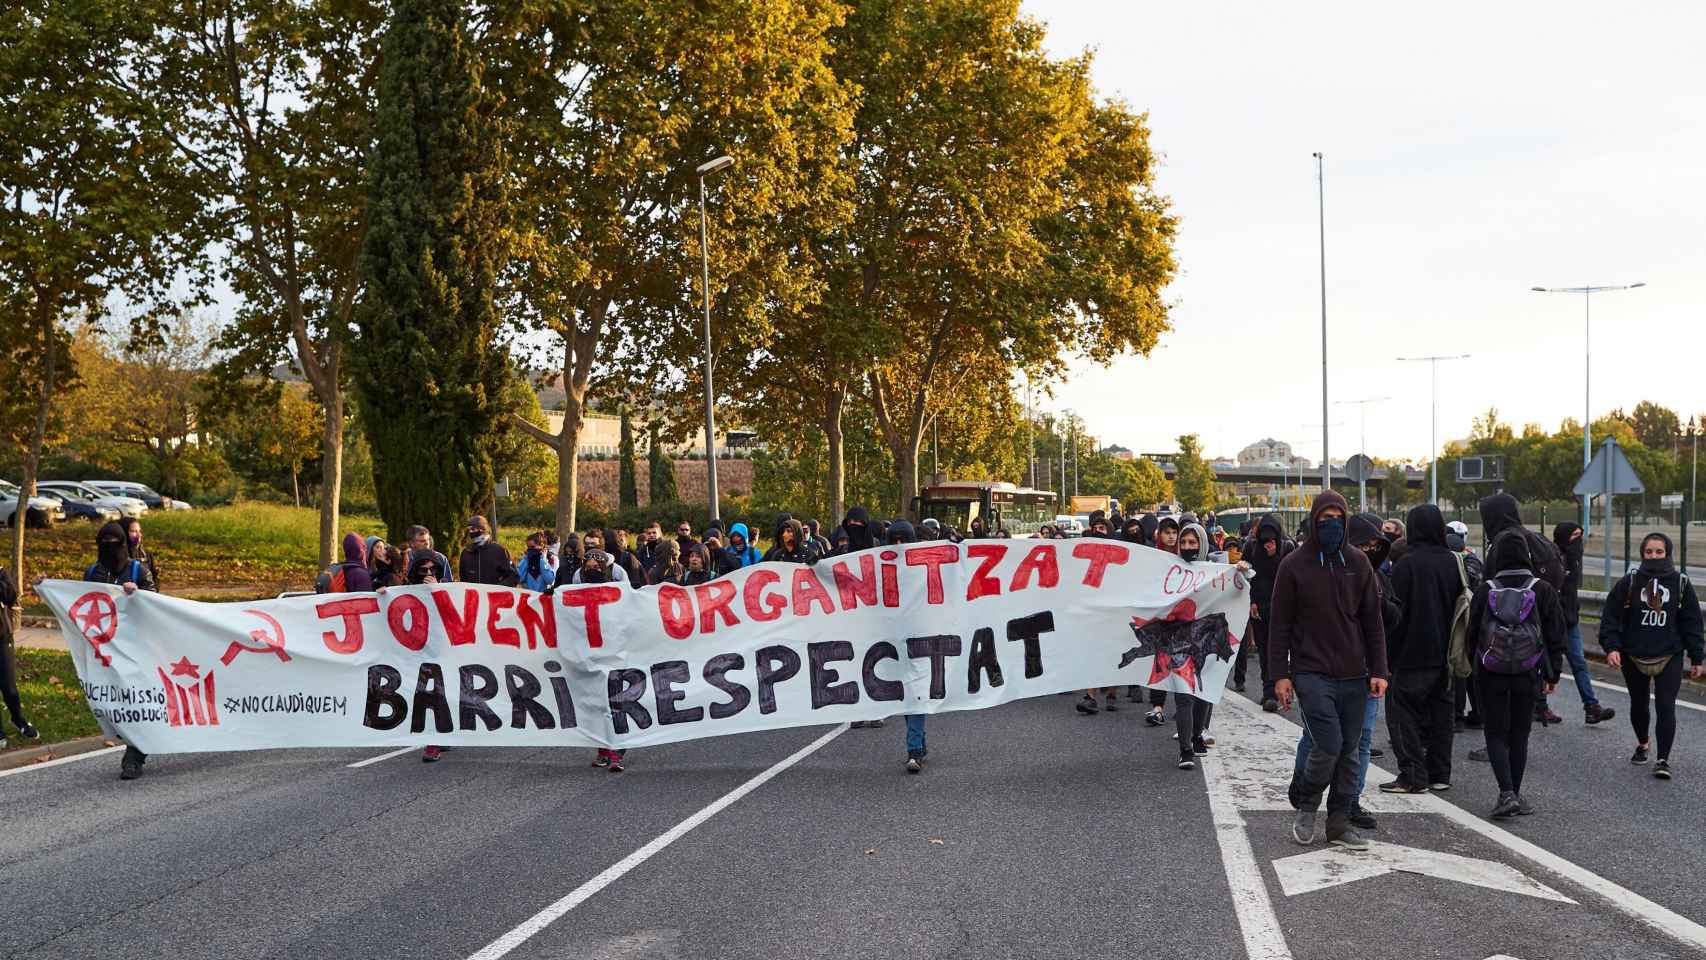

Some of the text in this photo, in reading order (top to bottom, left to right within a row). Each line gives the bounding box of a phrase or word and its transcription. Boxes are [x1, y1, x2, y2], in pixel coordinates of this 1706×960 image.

[315, 586, 622, 655] JOVENT
[1641, 610, 1667, 626] ZOO
[363, 610, 1055, 735] BARRi RESPECTAT
